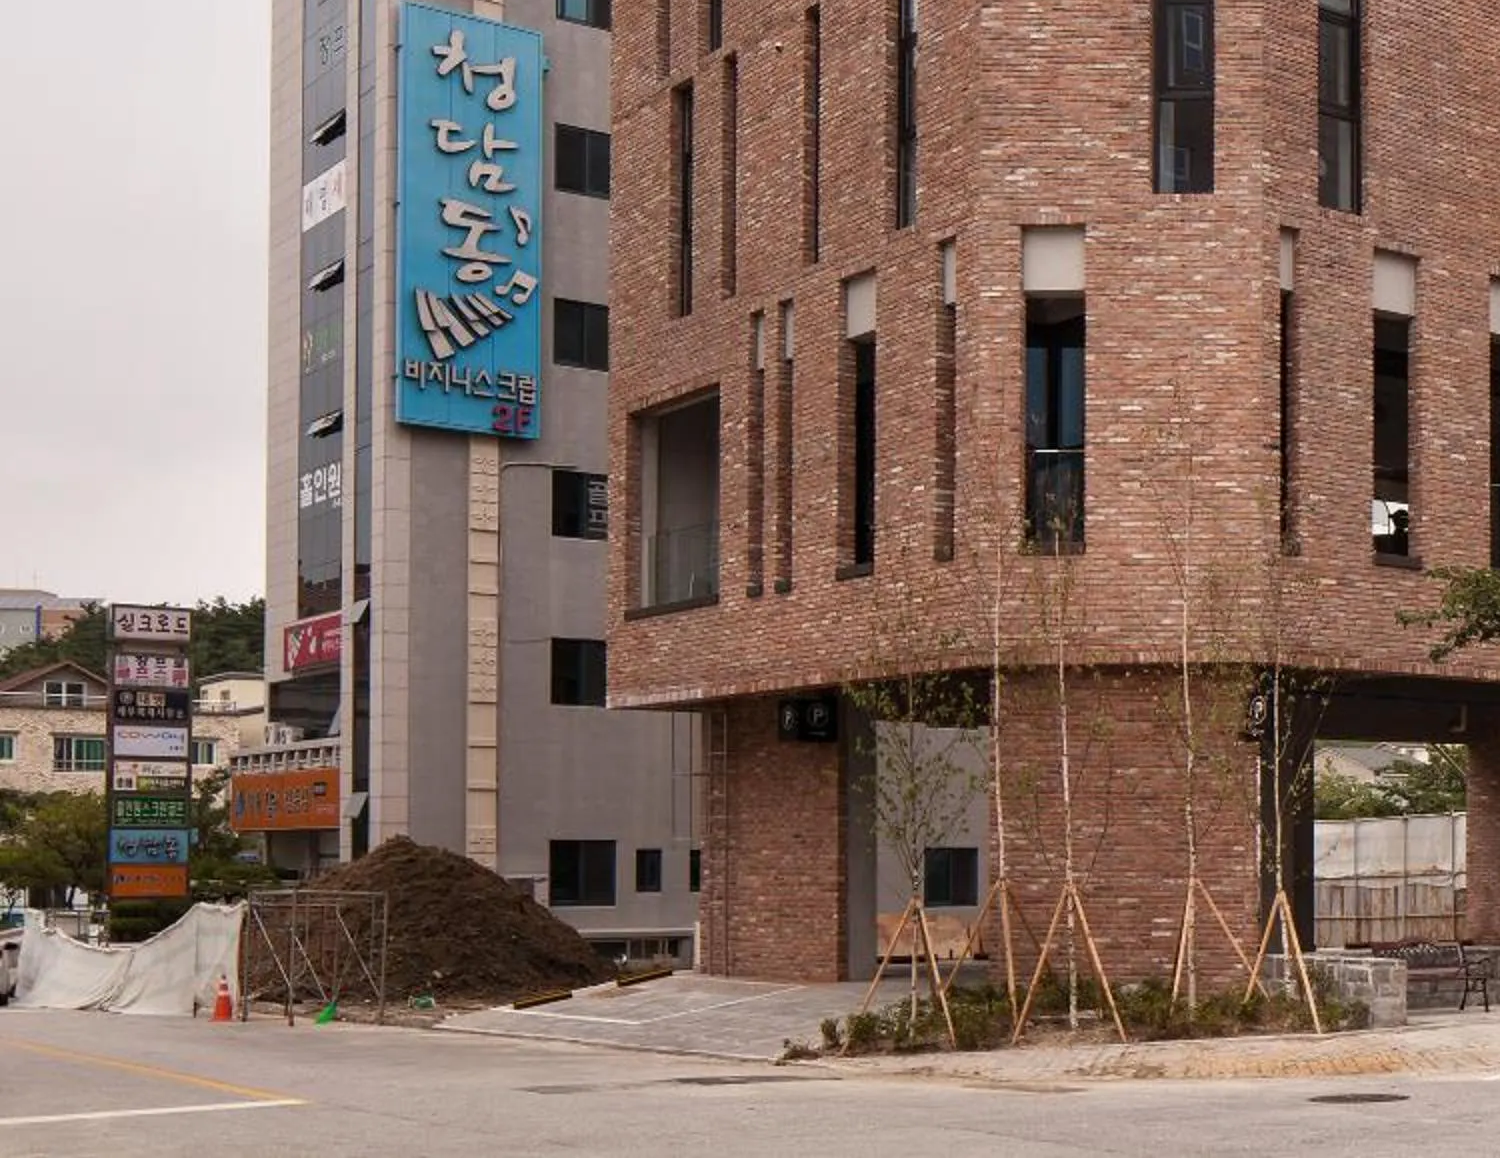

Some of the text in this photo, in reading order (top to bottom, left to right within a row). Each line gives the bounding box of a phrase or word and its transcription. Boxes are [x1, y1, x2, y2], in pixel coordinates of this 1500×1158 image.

[431, 28, 519, 284] 청담동
[491, 404, 533, 433] 2F
[117, 613, 188, 634] 실크로드
